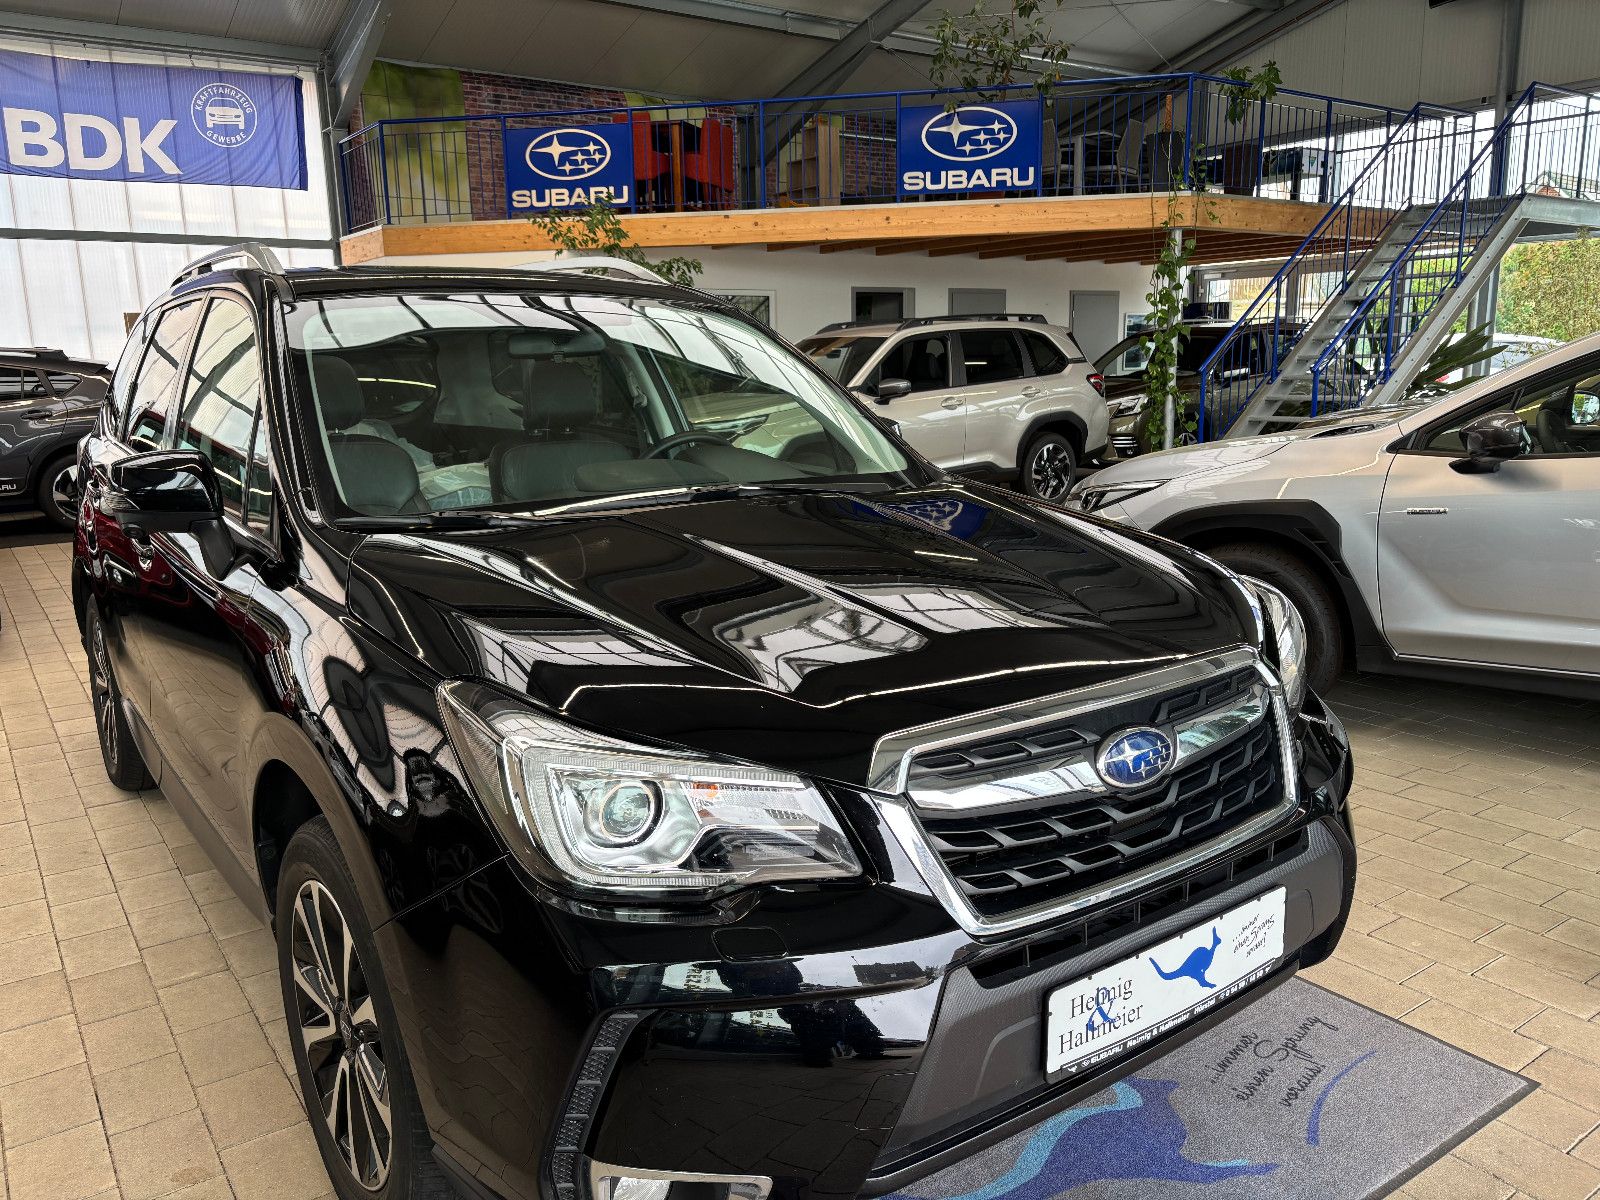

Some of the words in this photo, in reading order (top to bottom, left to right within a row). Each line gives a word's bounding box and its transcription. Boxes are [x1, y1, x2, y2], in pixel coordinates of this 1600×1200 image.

[195, 86, 253, 113] KRAFTFAHRZEUG
[3, 107, 183, 175] BDK
[206, 130, 246, 144] GEWERBE
[903, 166, 1035, 191] SUBARU
[511, 185, 629, 208] SUBARU
[1069, 977, 1133, 1020] Helmig
[1252, 1016, 1340, 1063] Sprung
[1090, 1045, 1123, 1064] SUBARU
